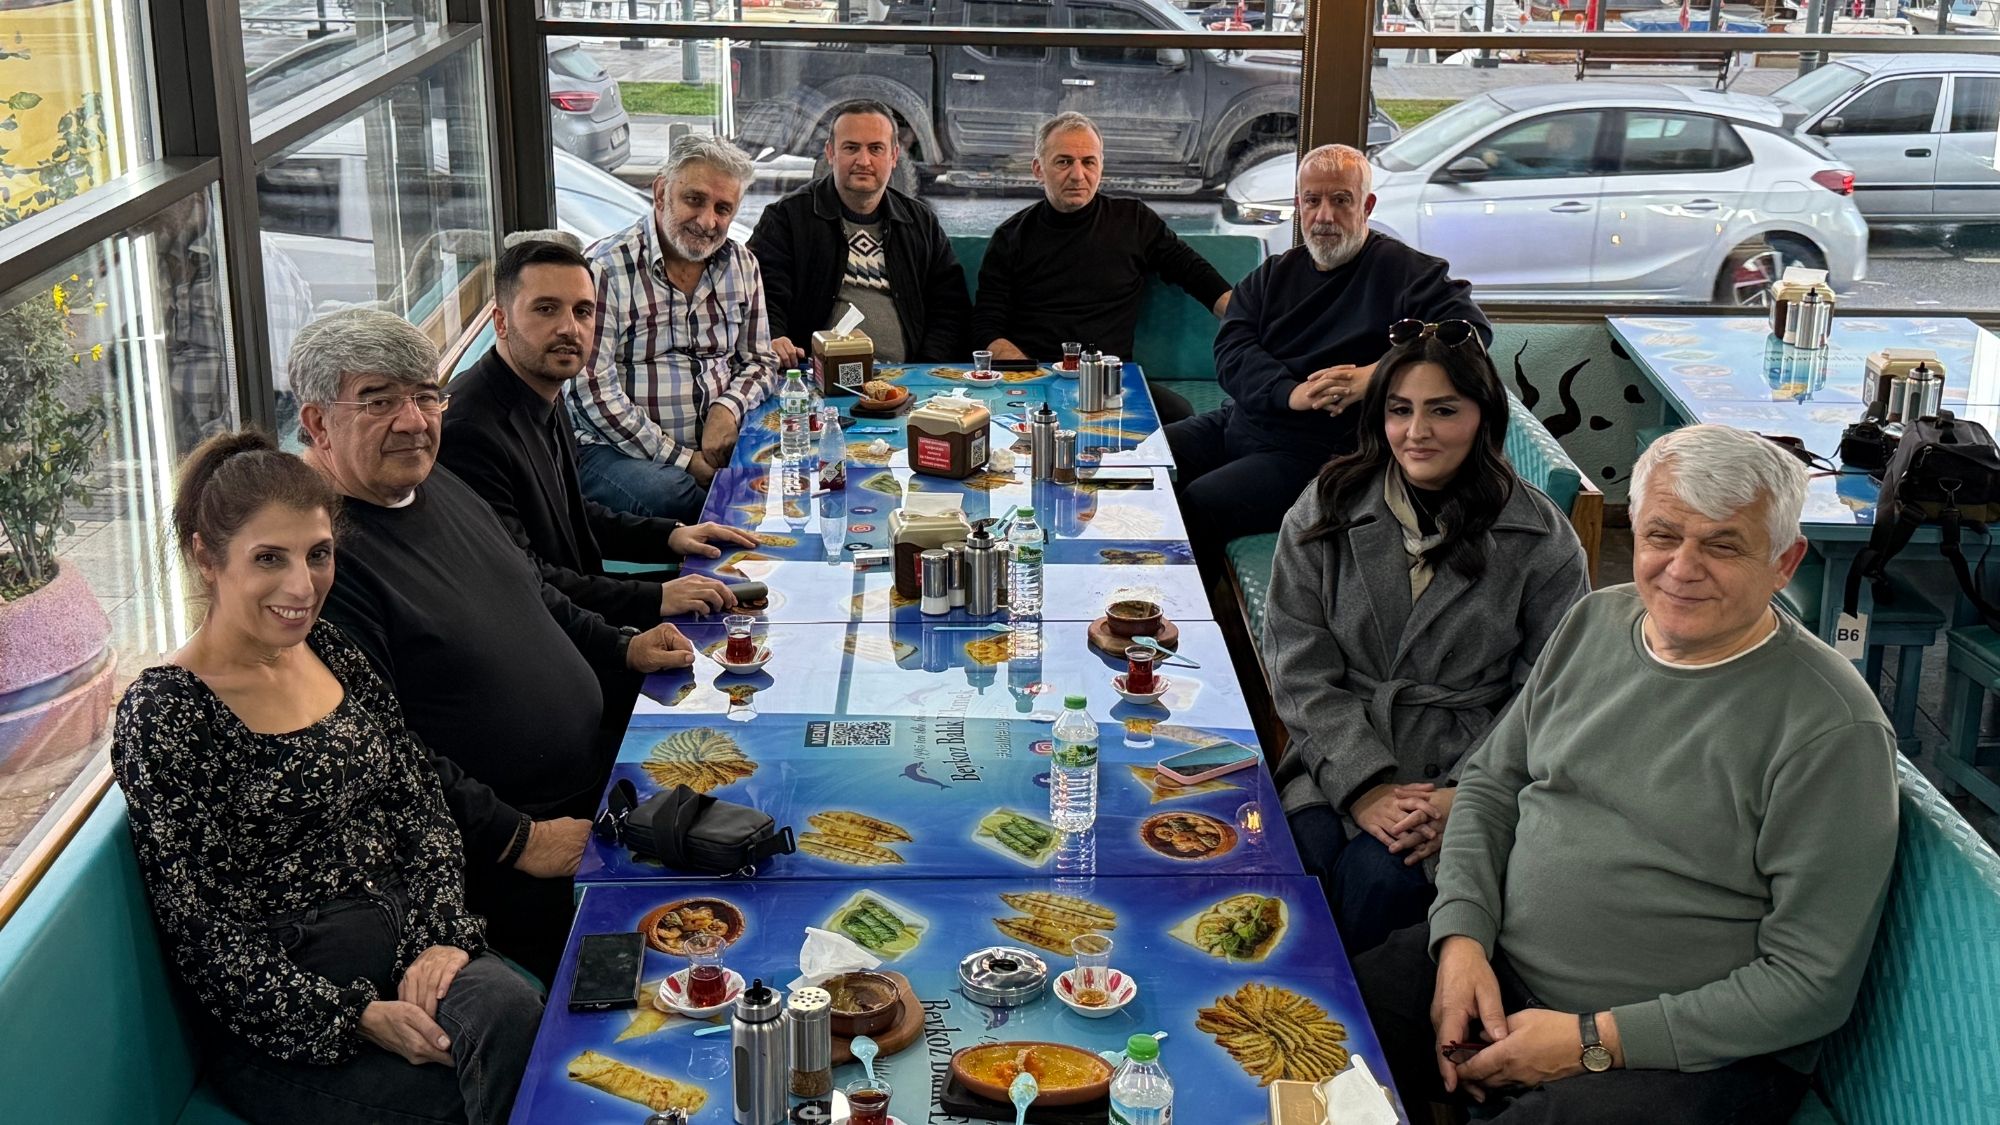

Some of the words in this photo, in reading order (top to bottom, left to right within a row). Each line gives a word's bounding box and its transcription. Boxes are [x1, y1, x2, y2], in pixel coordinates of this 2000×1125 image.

[1838, 629, 1859, 641] B6
[811, 724, 826, 744] MENÜ
[935, 720, 965, 745] Balık
[942, 746, 984, 782] Beykoz
